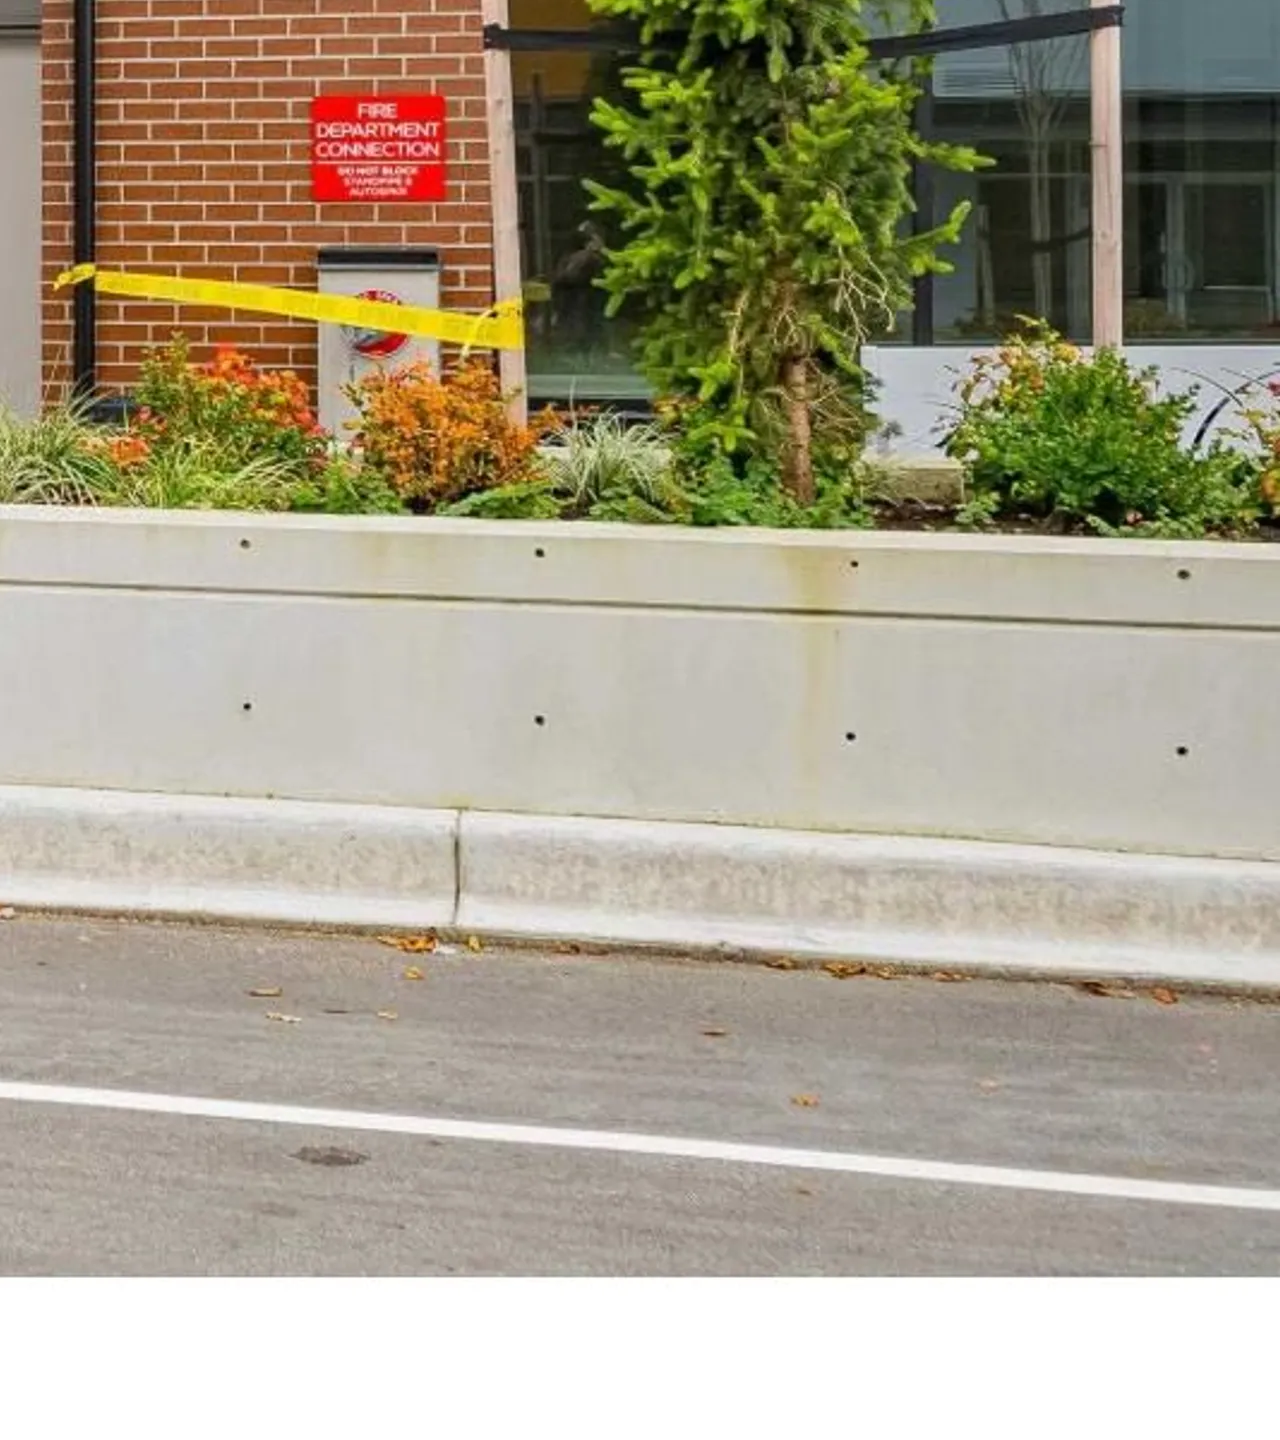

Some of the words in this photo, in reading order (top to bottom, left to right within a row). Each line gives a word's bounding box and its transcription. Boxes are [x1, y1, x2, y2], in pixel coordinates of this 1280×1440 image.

[357, 102, 398, 119] FIRE
[315, 121, 441, 139] DEPARTMENT
[315, 141, 440, 158] CONNECTION
